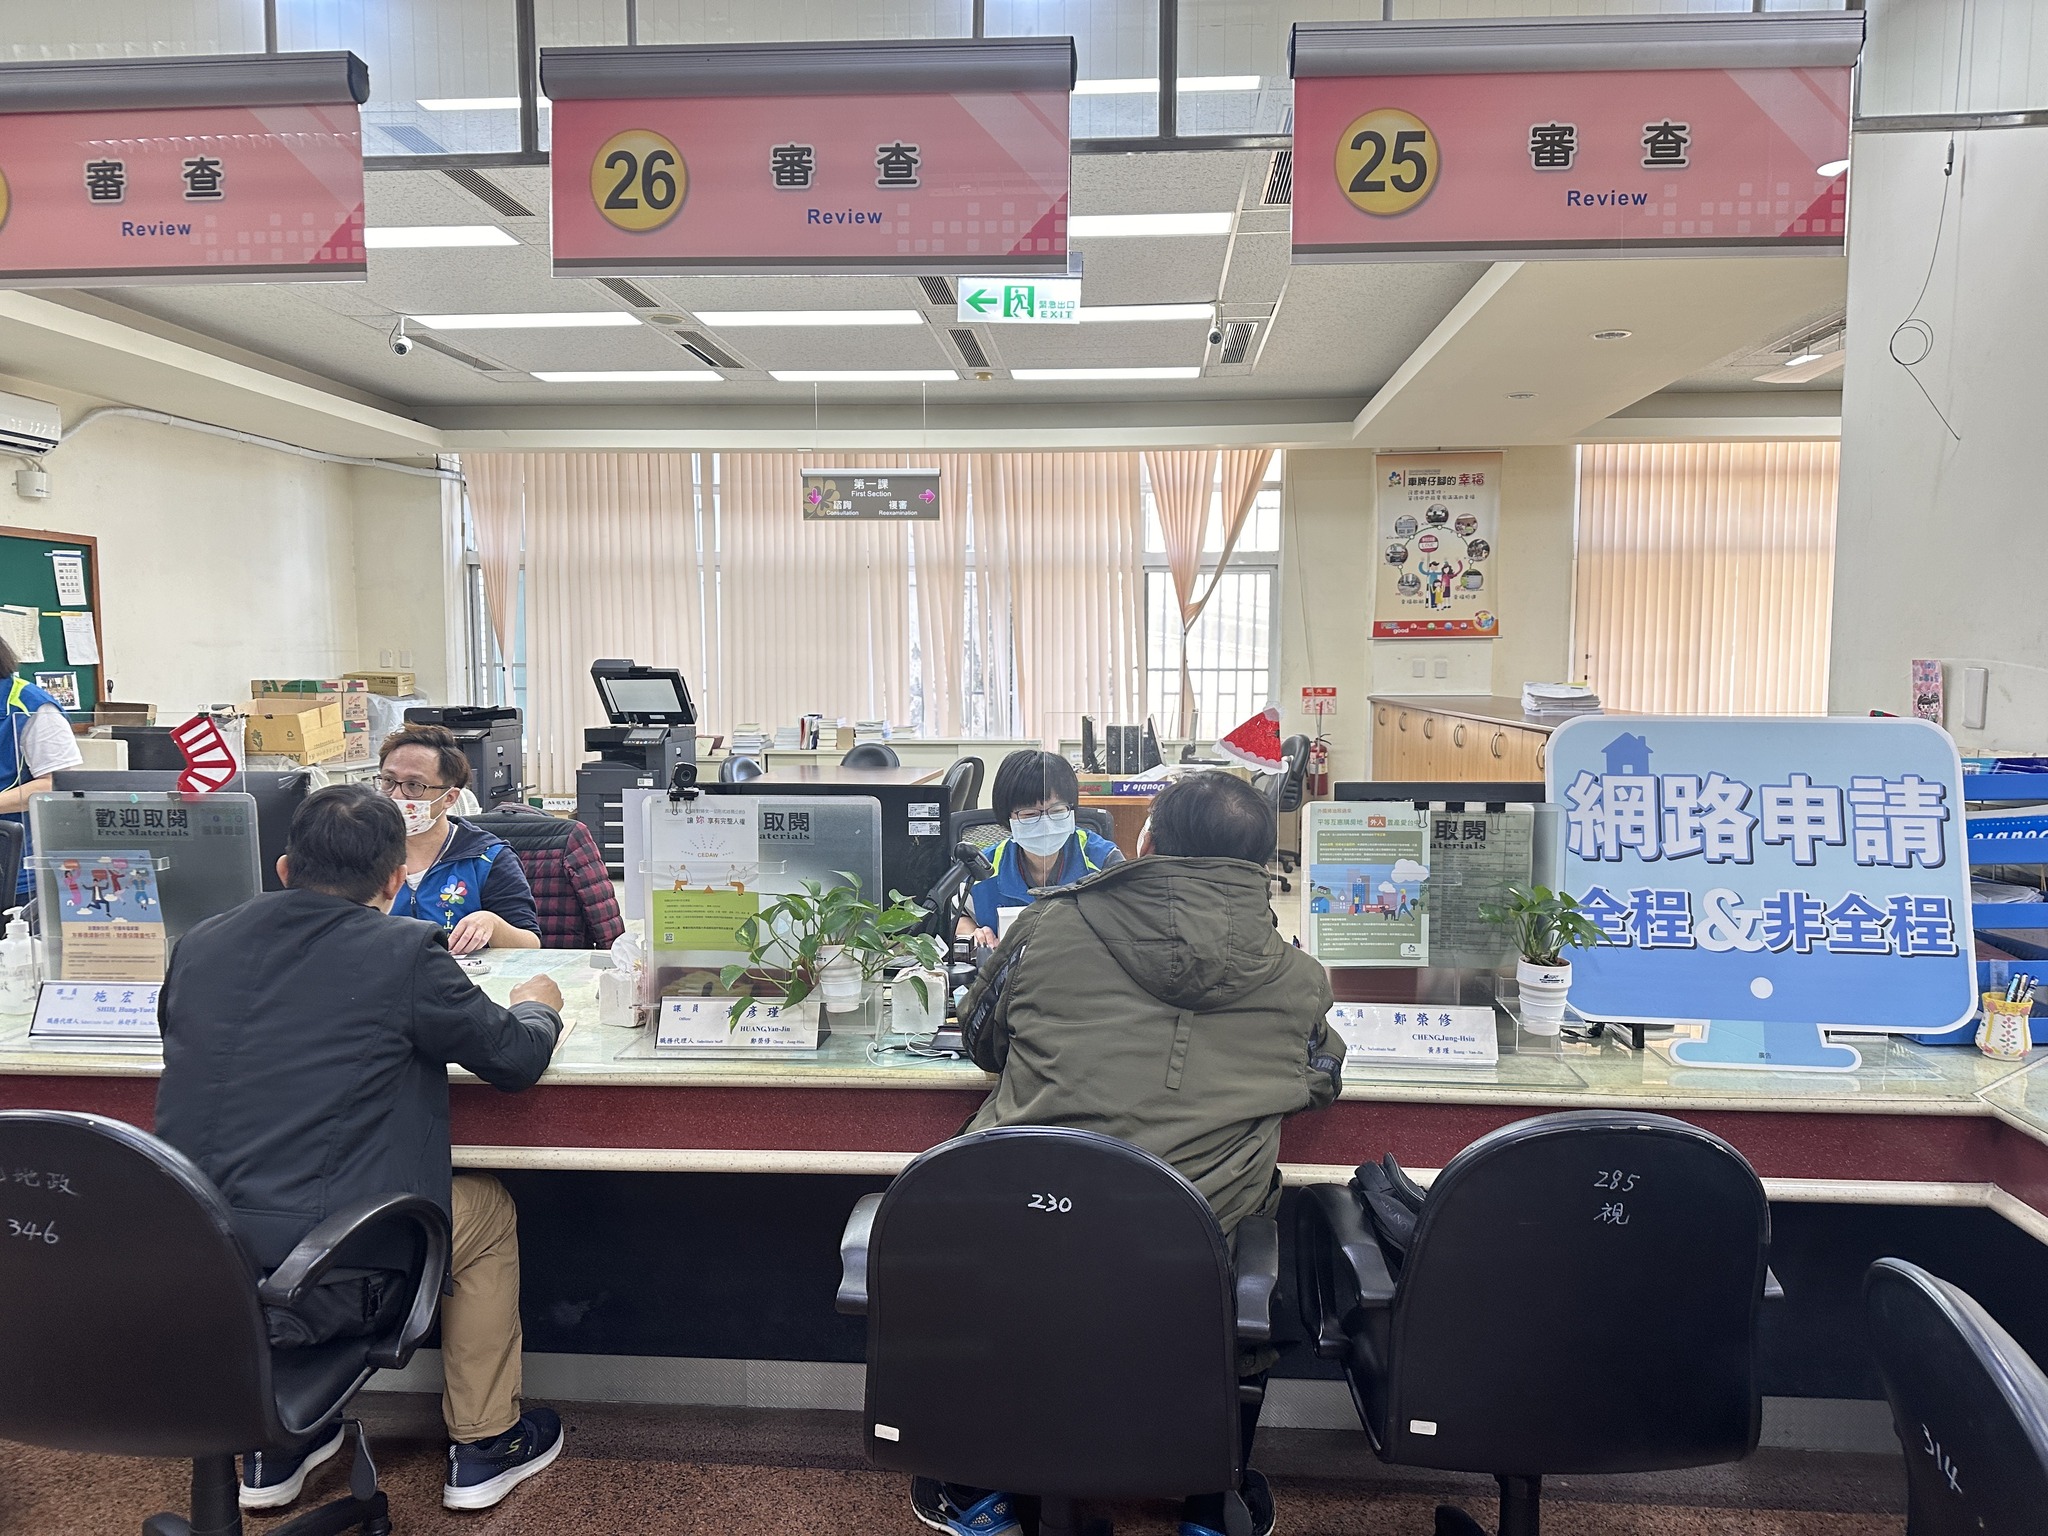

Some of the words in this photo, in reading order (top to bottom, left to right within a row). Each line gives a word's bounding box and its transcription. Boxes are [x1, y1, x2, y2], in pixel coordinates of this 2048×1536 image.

[1348, 130, 1427, 193] 25
[604, 149, 677, 210] 26
[1566, 188, 1648, 207] Review
[807, 208, 883, 225] Review
[121, 220, 192, 237] Review
[1038, 300, 1075, 309] 緊急出口
[1040, 310, 1073, 319] EXIT
[853, 478, 889, 490] 第一課
[1458, 472, 1485, 487] 幸福
[1122, 783, 1131, 792] A
[1132, 783, 1165, 791] Double
[95, 808, 188, 829] 歡迎取閱
[763, 811, 810, 832] 取閱
[1566, 770, 1949, 867] 網路申請
[127, 829, 189, 838] Materials
[758, 832, 811, 841] aterials
[1434, 820, 1487, 841] 取閱
[1430, 841, 1487, 850] aterials
[1393, 1012, 1453, 1027] 鄭榮修
[0, 1168, 79, 1196] 地政
[1593, 1169, 1641, 1192] 285
[1027, 1193, 1073, 1213] 230
[1593, 1202, 1631, 1225] 視
[7, 1218, 59, 1244] 346
[1921, 1423, 1963, 1495] 314
